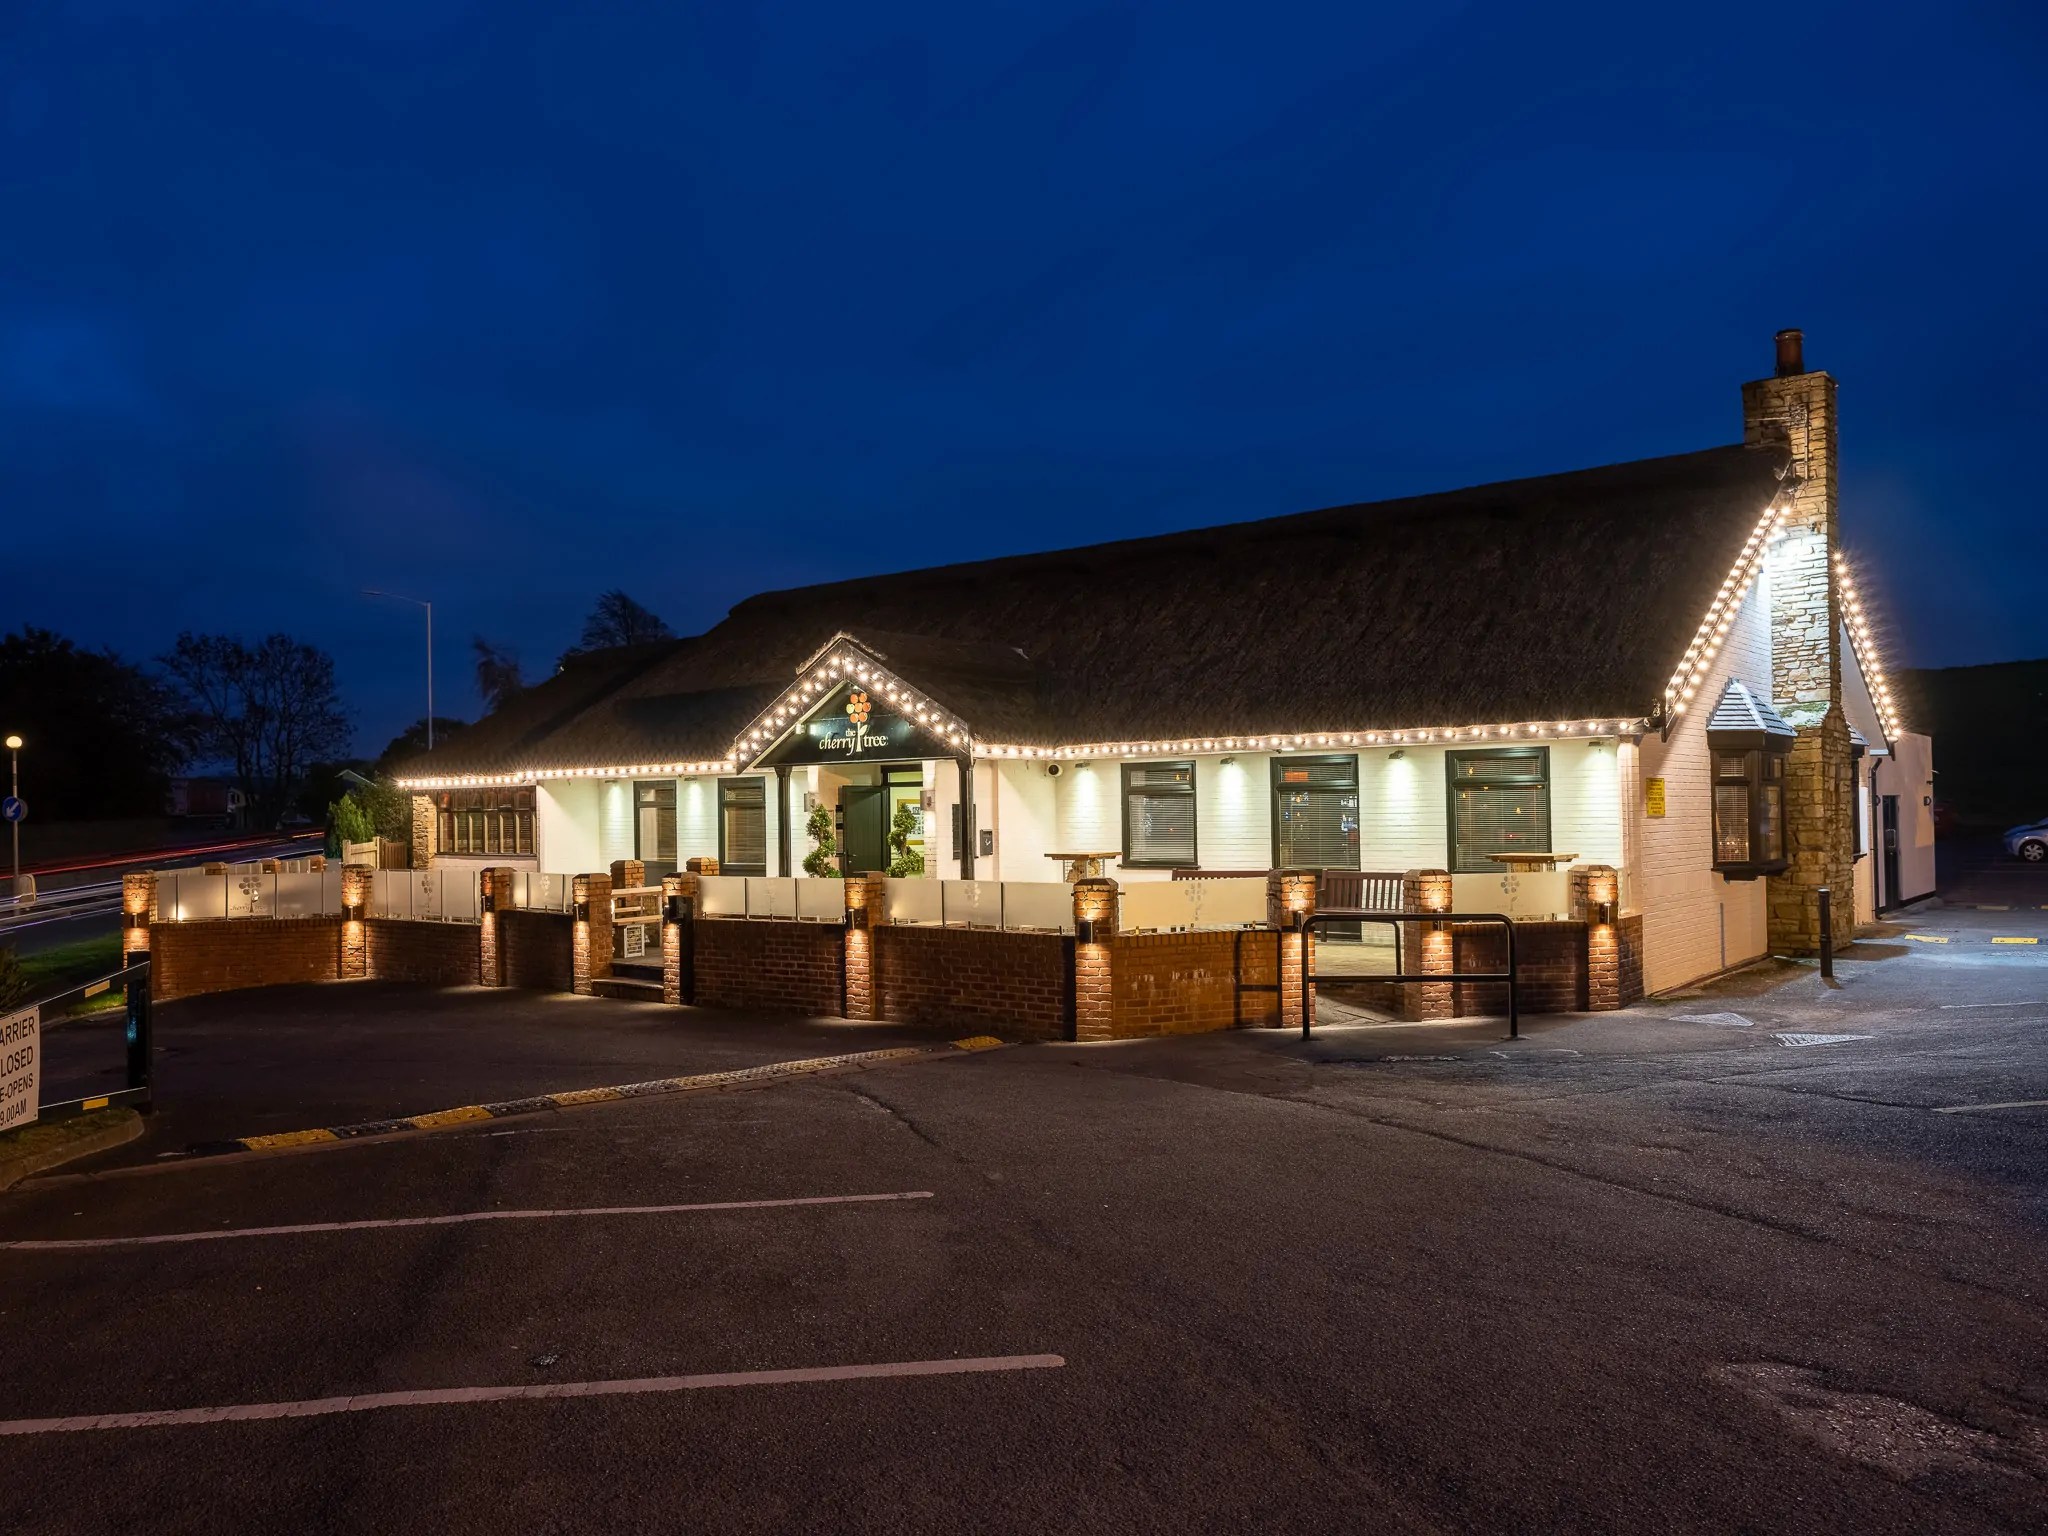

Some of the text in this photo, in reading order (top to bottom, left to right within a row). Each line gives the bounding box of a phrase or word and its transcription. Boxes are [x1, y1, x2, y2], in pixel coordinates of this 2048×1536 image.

[819, 731, 887, 756] cherry tree
[845, 729, 856, 737] the
[0, 1046, 34, 1078] LOSED
